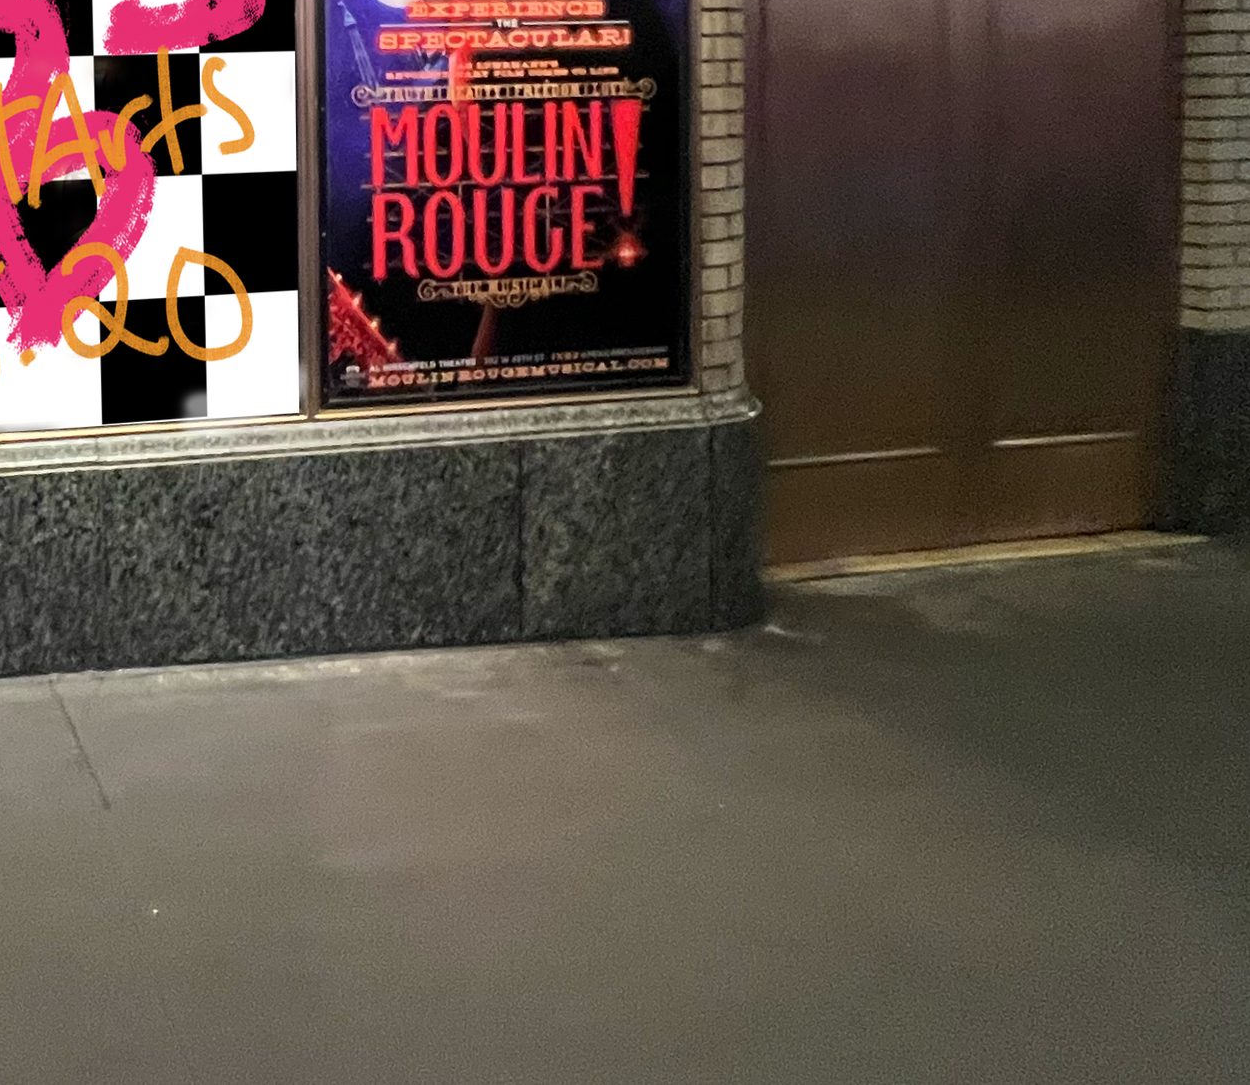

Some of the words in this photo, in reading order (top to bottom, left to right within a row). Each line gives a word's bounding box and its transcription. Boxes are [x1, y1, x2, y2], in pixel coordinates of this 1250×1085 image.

[409, 1, 604, 17] EXPERIENCE
[379, 29, 630, 50] SPECTACULAR!
[367, 357, 669, 388] MOULINROUGEMUSICAL.COM
